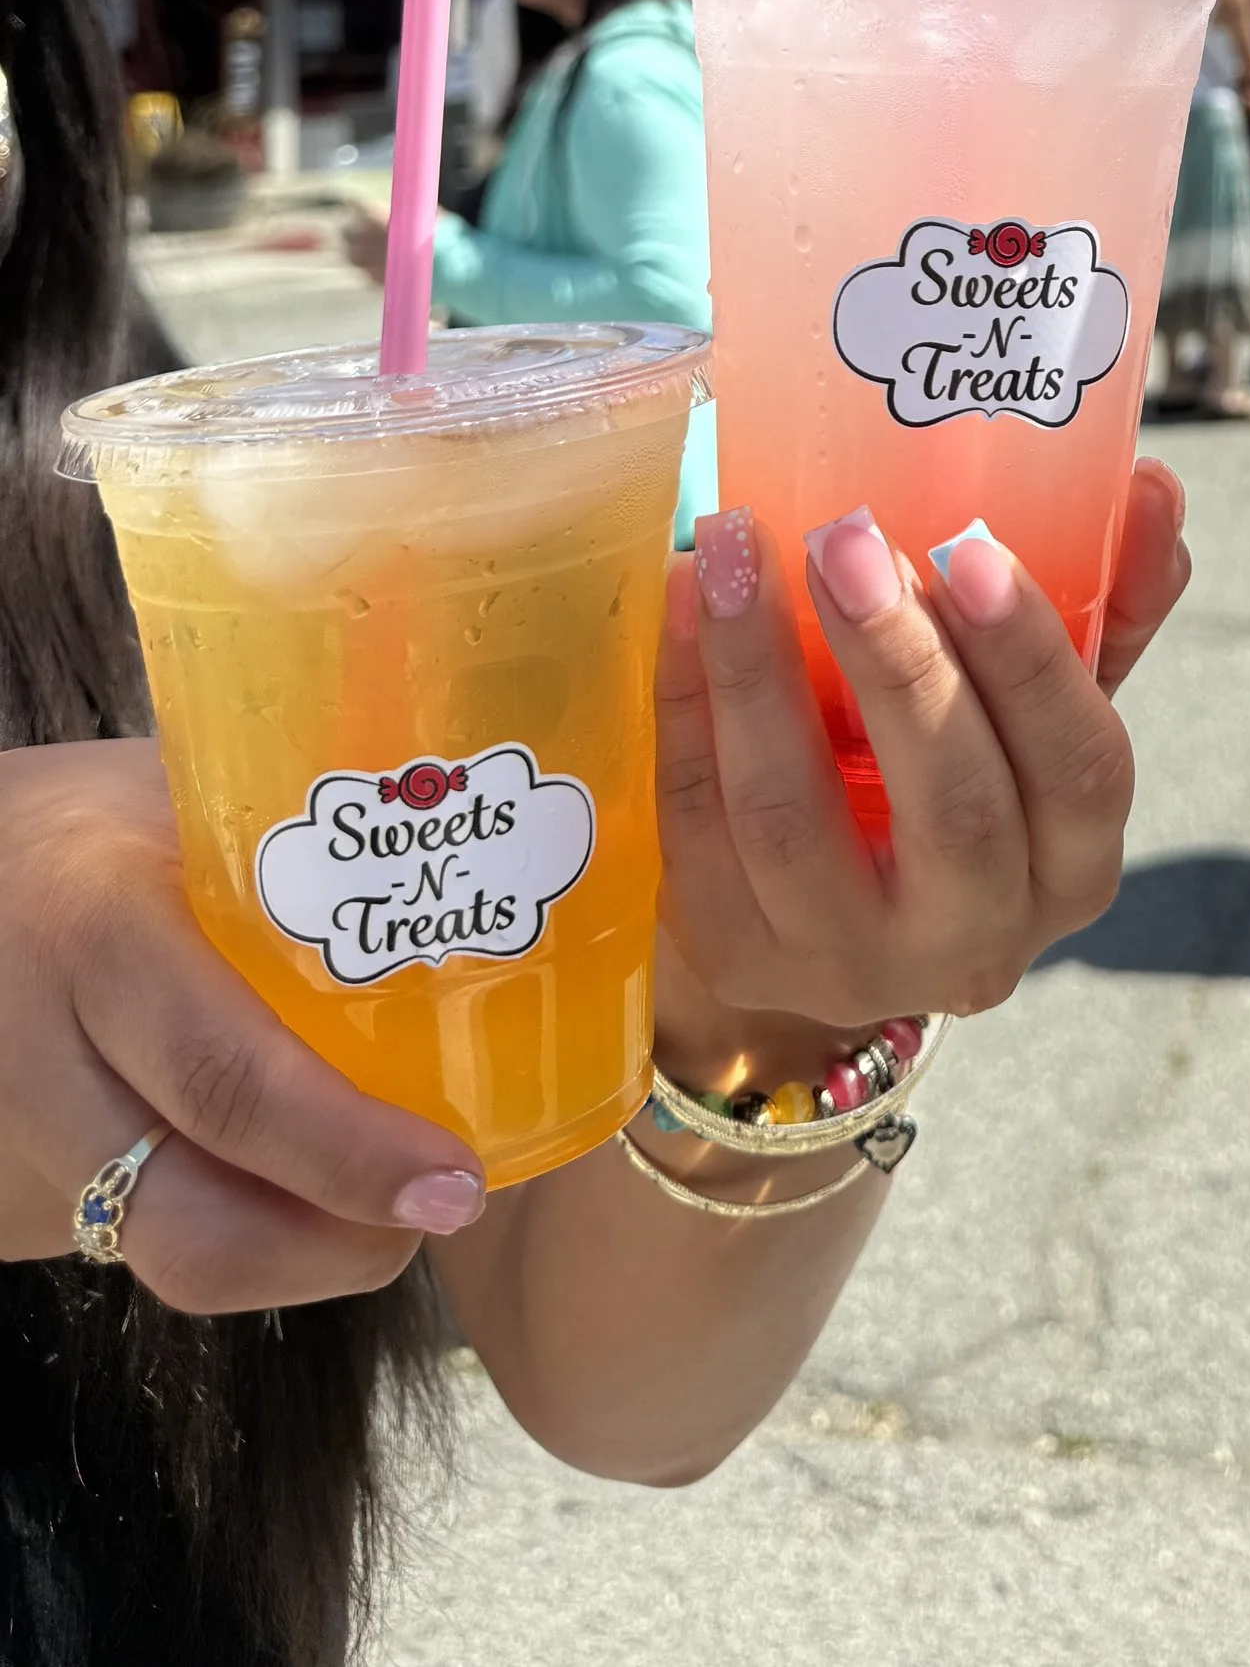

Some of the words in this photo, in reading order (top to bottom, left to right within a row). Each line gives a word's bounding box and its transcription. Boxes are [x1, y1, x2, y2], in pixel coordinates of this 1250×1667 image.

[911, 248, 1078, 309] Sweets
[962, 315, 1033, 359] -N-
[901, 341, 1064, 402] Treats
[328, 793, 516, 862] Sweets
[391, 853, 470, 906] -N-
[331, 889, 517, 955] Treats
